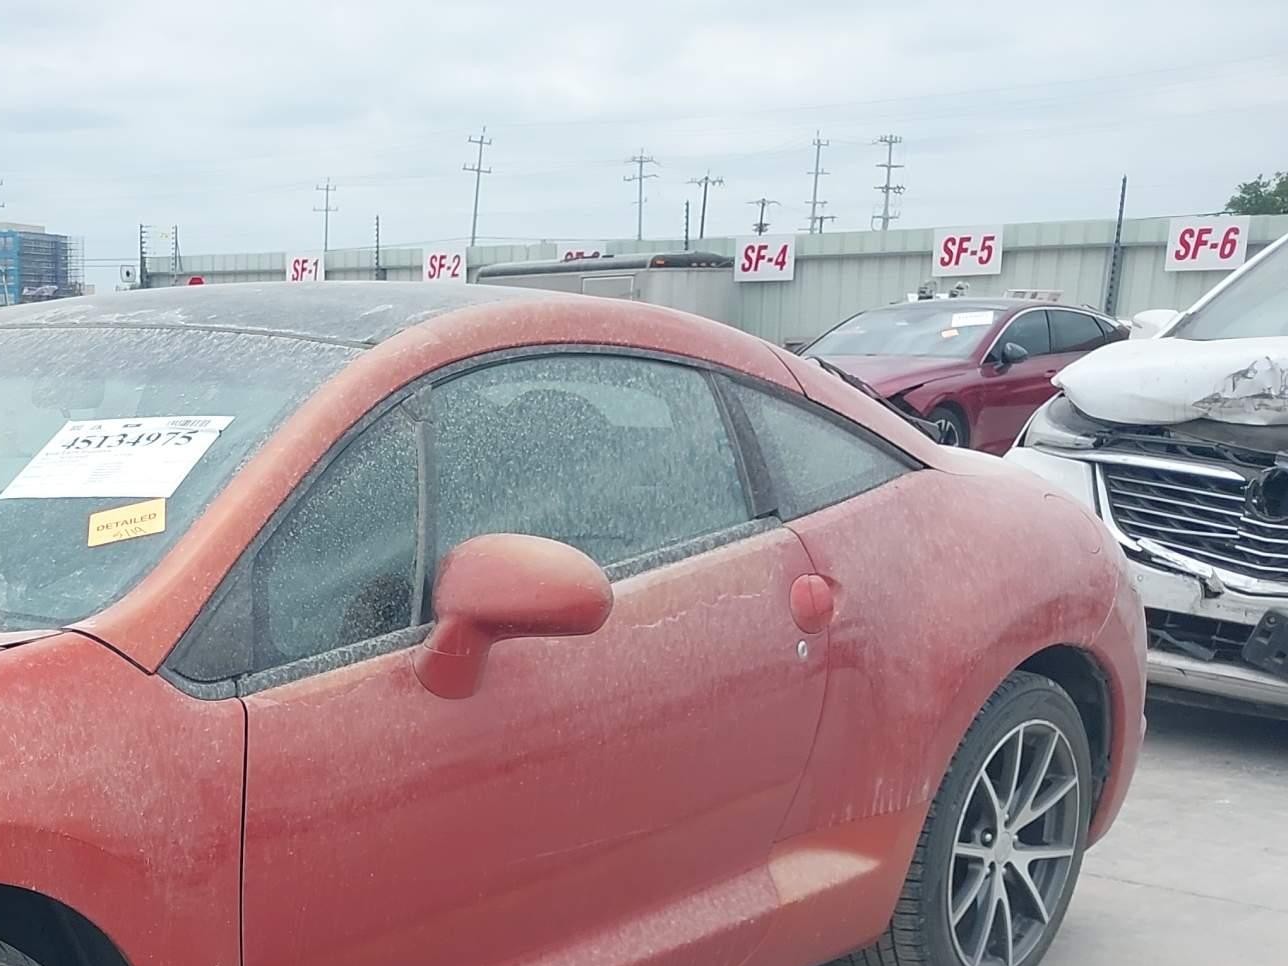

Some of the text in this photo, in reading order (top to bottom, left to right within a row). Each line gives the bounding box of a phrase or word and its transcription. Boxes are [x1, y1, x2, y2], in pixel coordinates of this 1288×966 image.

[940, 236, 995, 267] SF-5
[1175, 227, 1240, 260] SF-6
[292, 259, 319, 280] SF-1
[428, 254, 461, 279] SF-2
[741, 244, 788, 272] SF-4
[62, 430, 200, 450] 45134975
[96, 512, 157, 532] DETAILED
